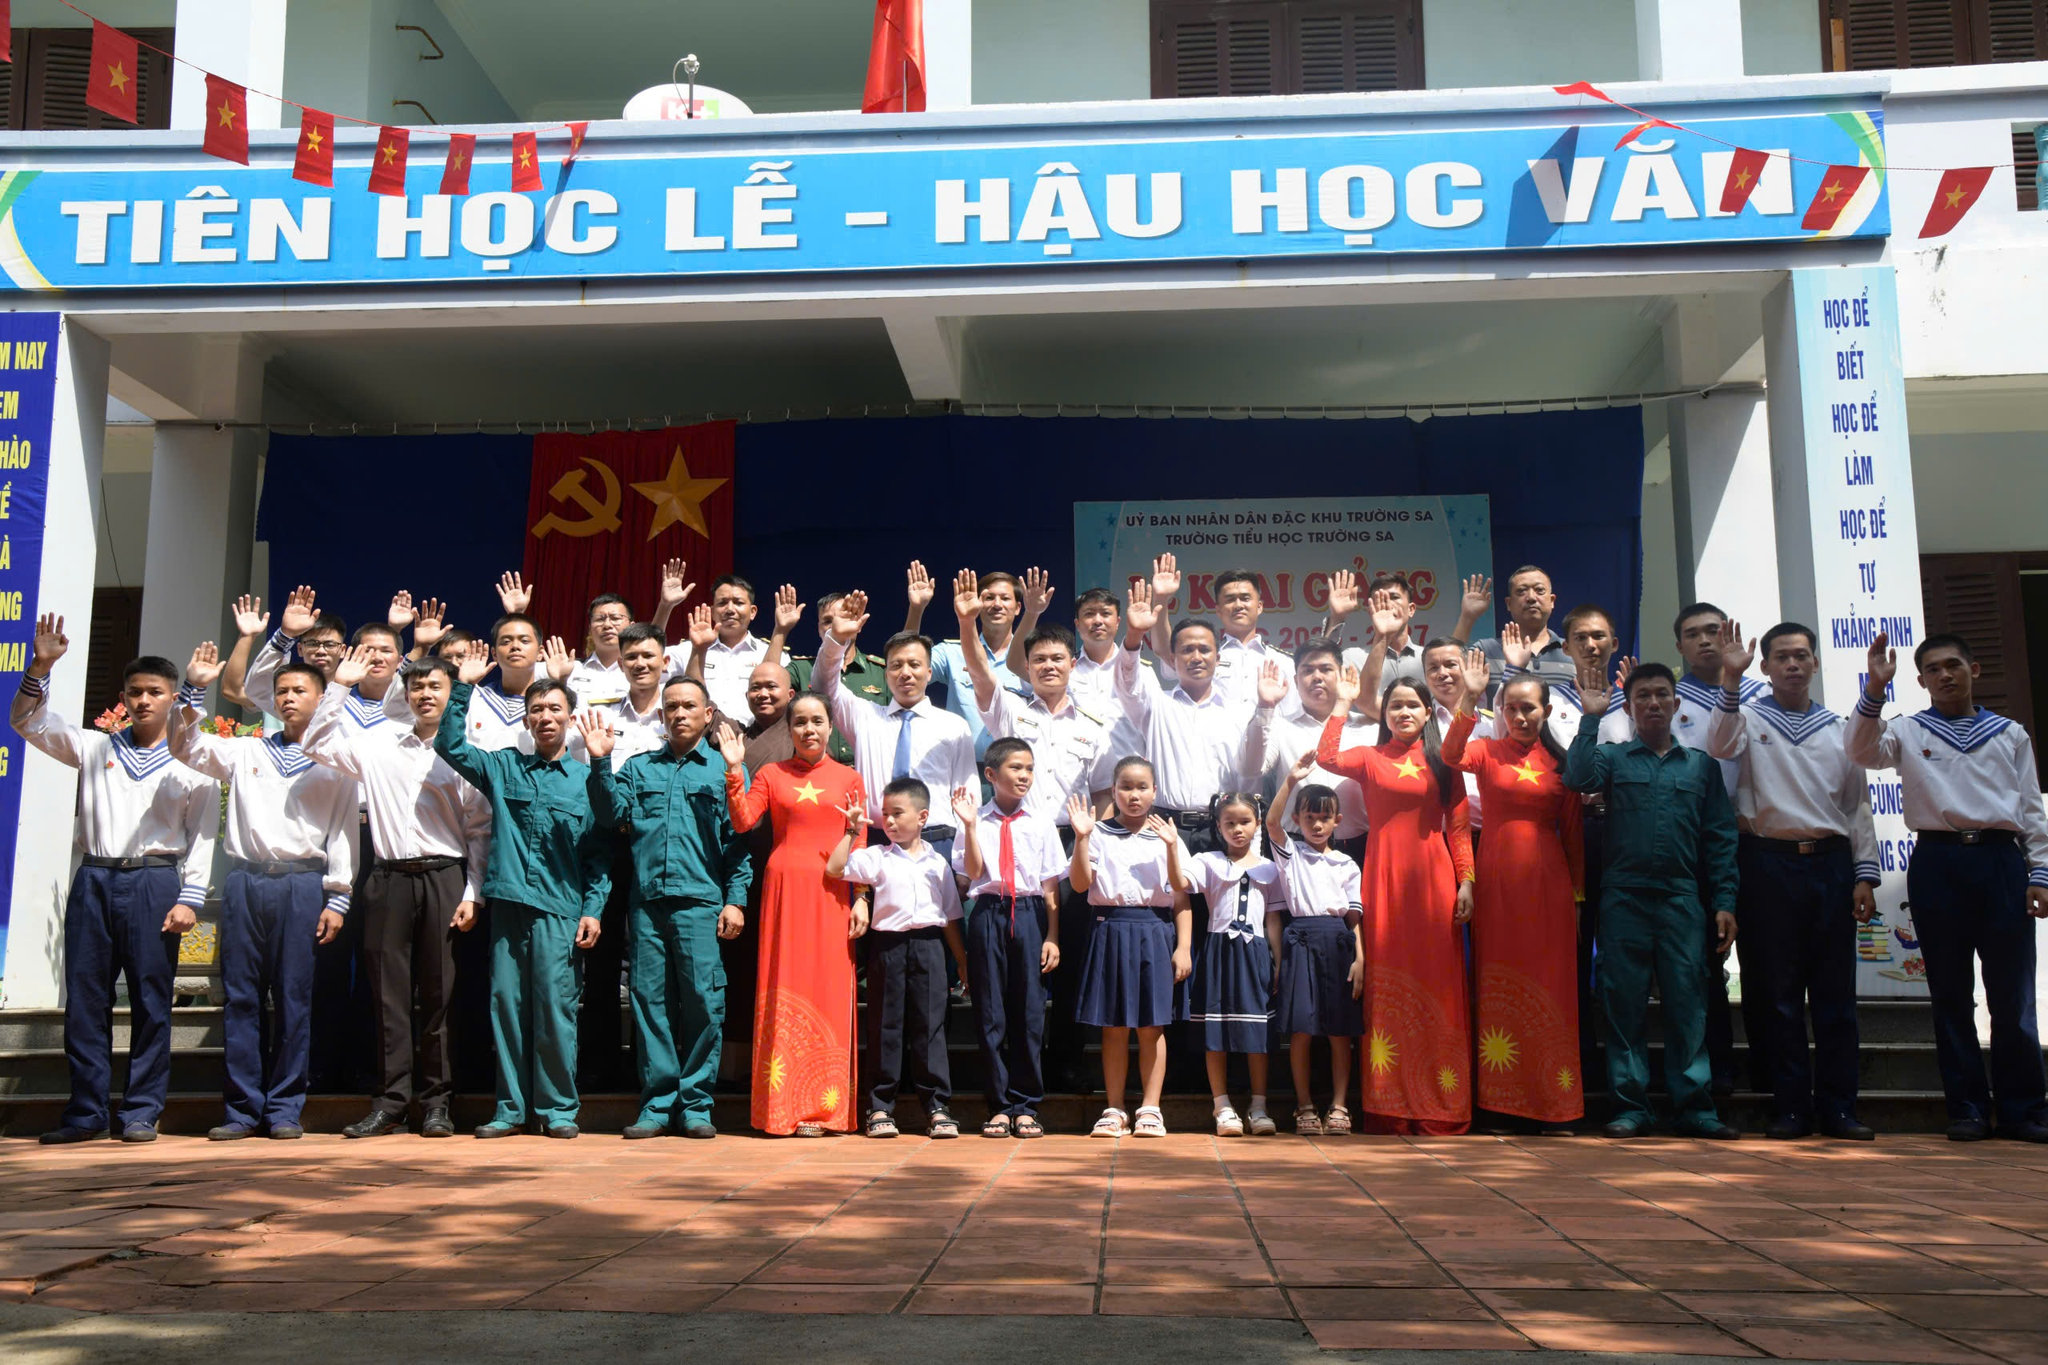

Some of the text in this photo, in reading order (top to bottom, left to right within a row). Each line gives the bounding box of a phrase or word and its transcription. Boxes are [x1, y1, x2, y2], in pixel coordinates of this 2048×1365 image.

[60, 185, 331, 264] TIÊN
[376, 189, 618, 270] HỌC
[665, 160, 798, 251] LỄ
[935, 162, 1182, 255] HẬU
[1230, 161, 1484, 245] HỌC
[1526, 139, 1794, 223] VĂN
[1823, 285, 1870, 335] HỌC ĐỂ
[14, 341, 48, 370] NAY
[1836, 340, 1864, 380] BIẾT
[1831, 389, 1879, 440] HỌC ĐỂ
[1844, 449, 1874, 486] LÀM
[1126, 507, 1434, 527] UỶ BAN NHÂN DÂN ĐẶC KHU TRƯỜNG SA
[1166, 527, 1395, 547] TRƯỜNG TIỂU HỌC TRƯỜNG SA
[1839, 495, 1887, 546] HỌC ĐỂ
[1186, 572, 1292, 611] KAI
[1858, 559, 1876, 600] TỰ
